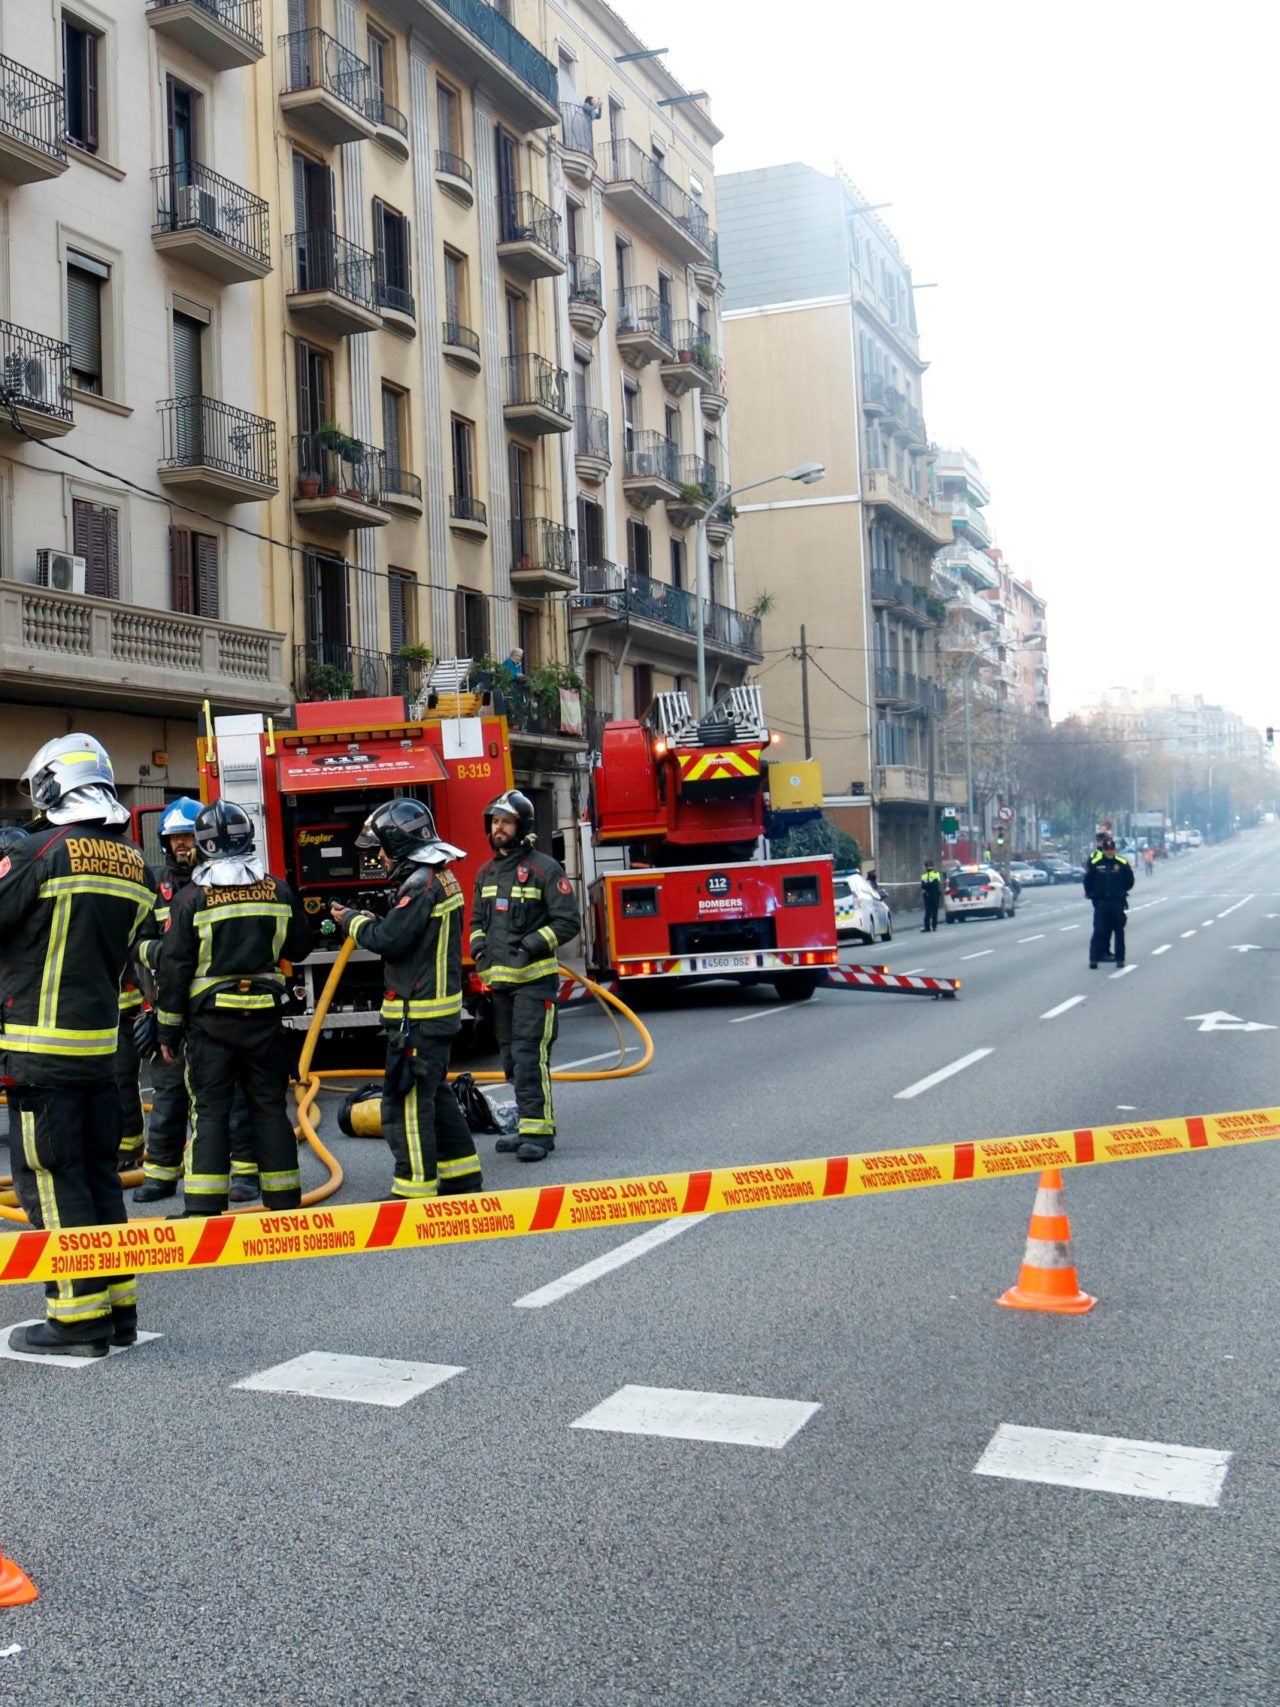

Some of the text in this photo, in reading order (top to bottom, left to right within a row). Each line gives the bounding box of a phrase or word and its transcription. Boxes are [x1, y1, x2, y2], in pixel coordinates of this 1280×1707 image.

[288, 761, 410, 774] BOMBERS
[324, 755, 369, 763] 112
[457, 762, 491, 779] B-319
[65, 837, 145, 869] BOMBERS
[70, 858, 144, 884] BARCELONA
[709, 878, 727, 888] 112
[206, 889, 278, 907] BARCELONA
[698, 898, 742, 909] BOMBERS
[708, 958, 729, 967] 4560
[1109, 1127, 1161, 1141] NO PASAR
[980, 1137, 1060, 1157] DO NOT CROSS
[862, 1153, 926, 1171] NO PASSAR
[732, 1167, 794, 1186] NO PASAR
[860, 1166, 942, 1189] BOMBERS BARCELONA
[572, 1180, 668, 1204] DO NOT CROSS
[722, 1180, 814, 1206] BOMBEROS BARCELONA
[423, 1197, 502, 1219] NO PASSAR
[570, 1196, 678, 1224] BARCELONA FIRE SERVICE
[260, 1212, 334, 1234] NO PASAR
[416, 1213, 515, 1240] BOMBERS BARCELONA
[59, 1226, 176, 1252] DO NOT CROSS
[243, 1230, 355, 1257] BOMBEROS BARCELONA
[51, 1246, 184, 1274] BARCELONA FIRE SERVICE
